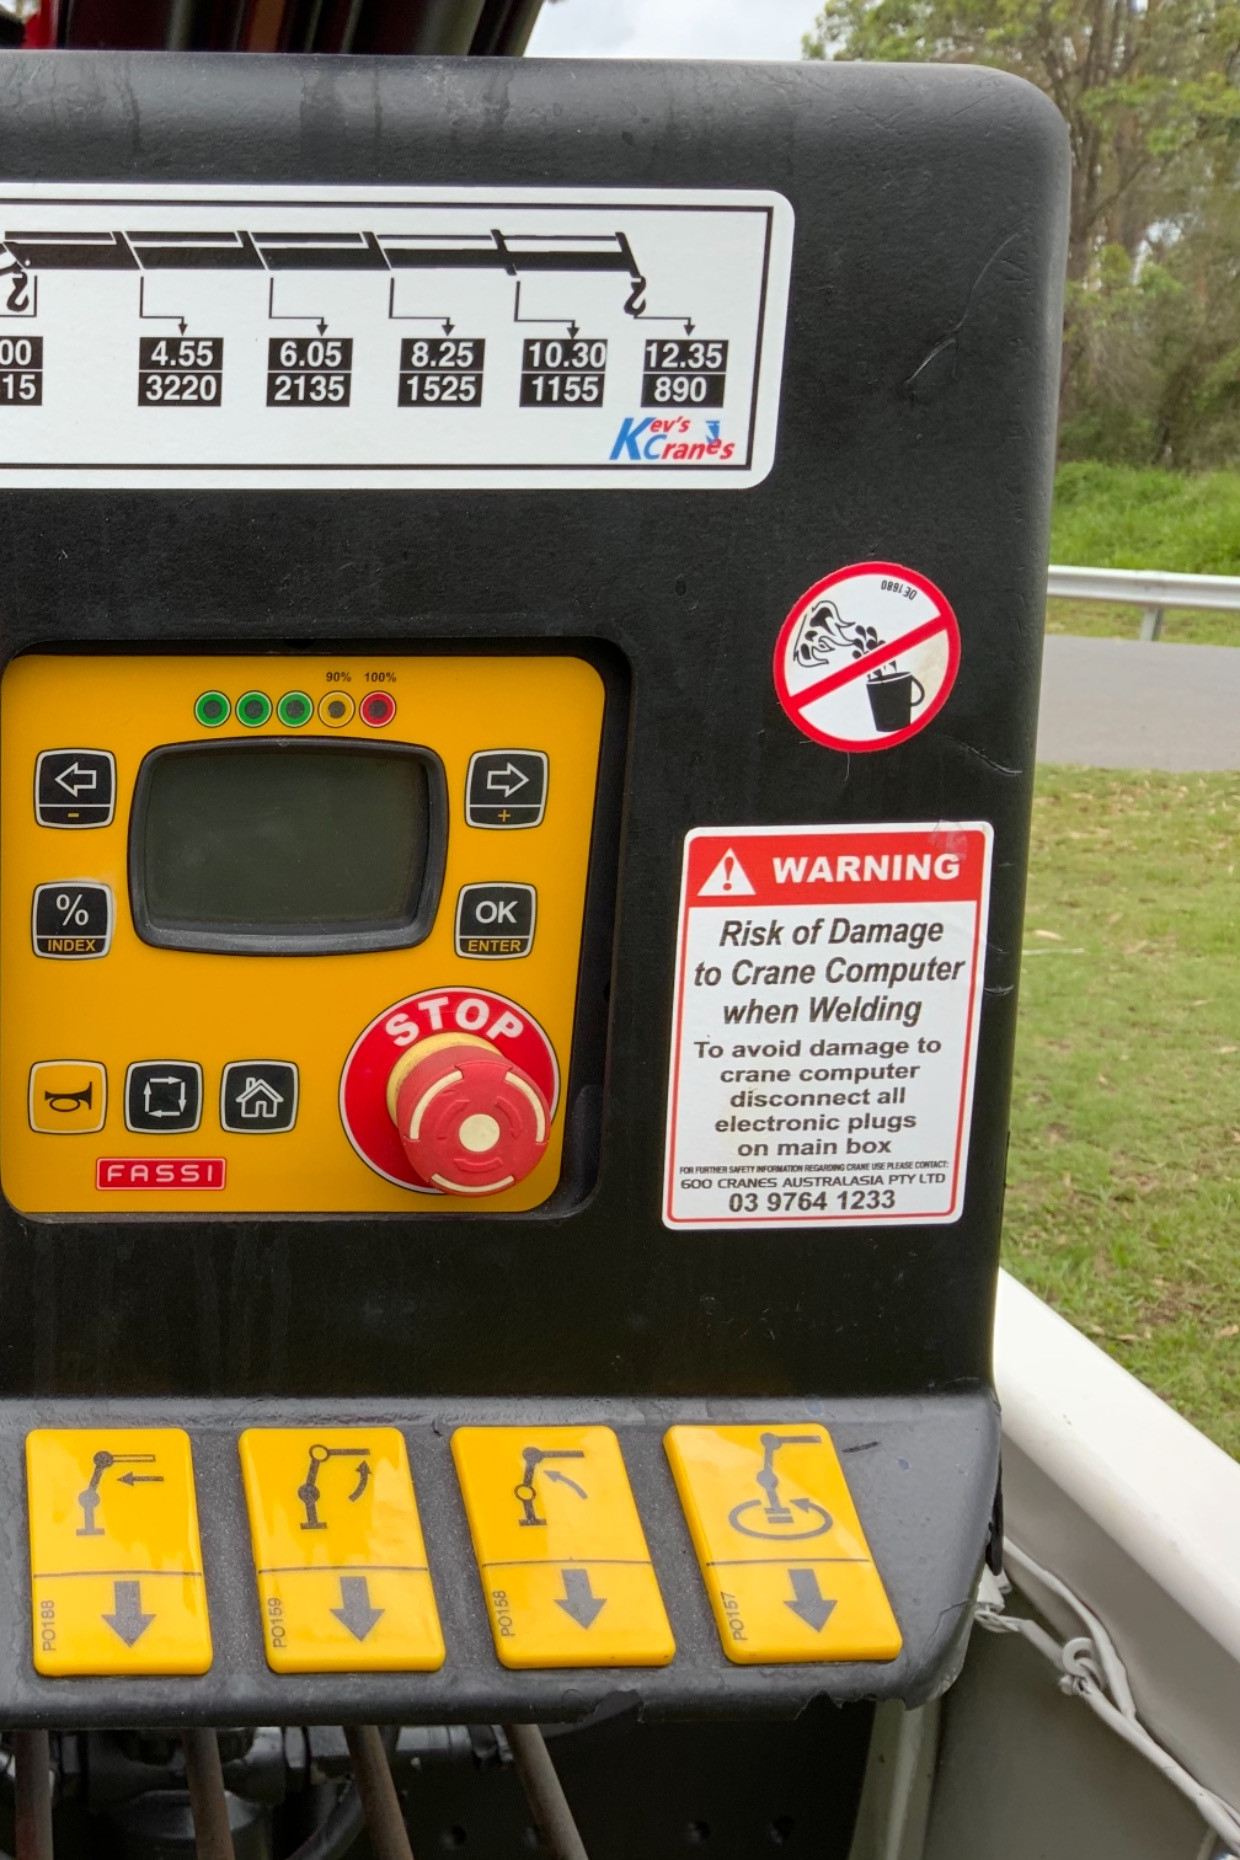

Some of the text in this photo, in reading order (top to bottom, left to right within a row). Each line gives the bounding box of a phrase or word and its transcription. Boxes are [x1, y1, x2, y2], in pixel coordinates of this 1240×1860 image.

[150, 341, 214, 367] 4.55
[279, 341, 343, 367] 6.05
[411, 341, 474, 368] 8.25
[528, 341, 607, 368] 10.30
[645, 342, 723, 369] 12.35
[145, 374, 218, 401] 3220
[274, 375, 346, 401] 2135
[406, 375, 476, 402] 1525
[531, 375, 599, 402] 1155
[653, 376, 707, 403] 890
[609, 415, 691, 461] Kev's
[643, 432, 736, 461] Cranes
[325, 671, 397, 684] 90% 100%
[773, 853, 960, 883] WARNING
[56, 893, 89, 927] %
[475, 900, 519, 924] OK
[719, 917, 944, 949] Risk of Damage
[47, 939, 96, 952] INDEX
[467, 939, 521, 952] ENTER
[694, 956, 965, 989] to Crane Computer
[385, 996, 524, 1047] STOP
[723, 996, 922, 1028] when Welding
[694, 1037, 942, 1059] To avoid damage to
[720, 1063, 921, 1085] crane computer
[730, 1086, 906, 1108] disconnect all
[714, 1112, 917, 1134] electronic plugs
[737, 1138, 892, 1157] on main box
[106, 1164, 215, 1183] FASSI
[679, 1159, 949, 1174] FOR FURTHER SAFETY INFORMATION REGARDING CRANE USE PLEASE CONTACT:
[717, 1177, 778, 1188] CRANES
[782, 1174, 884, 1187] AUSTRALASIA
[888, 1173, 916, 1184] PTY
[919, 1172, 946, 1184] LTD
[728, 1189, 896, 1213] 03 9764 1233
